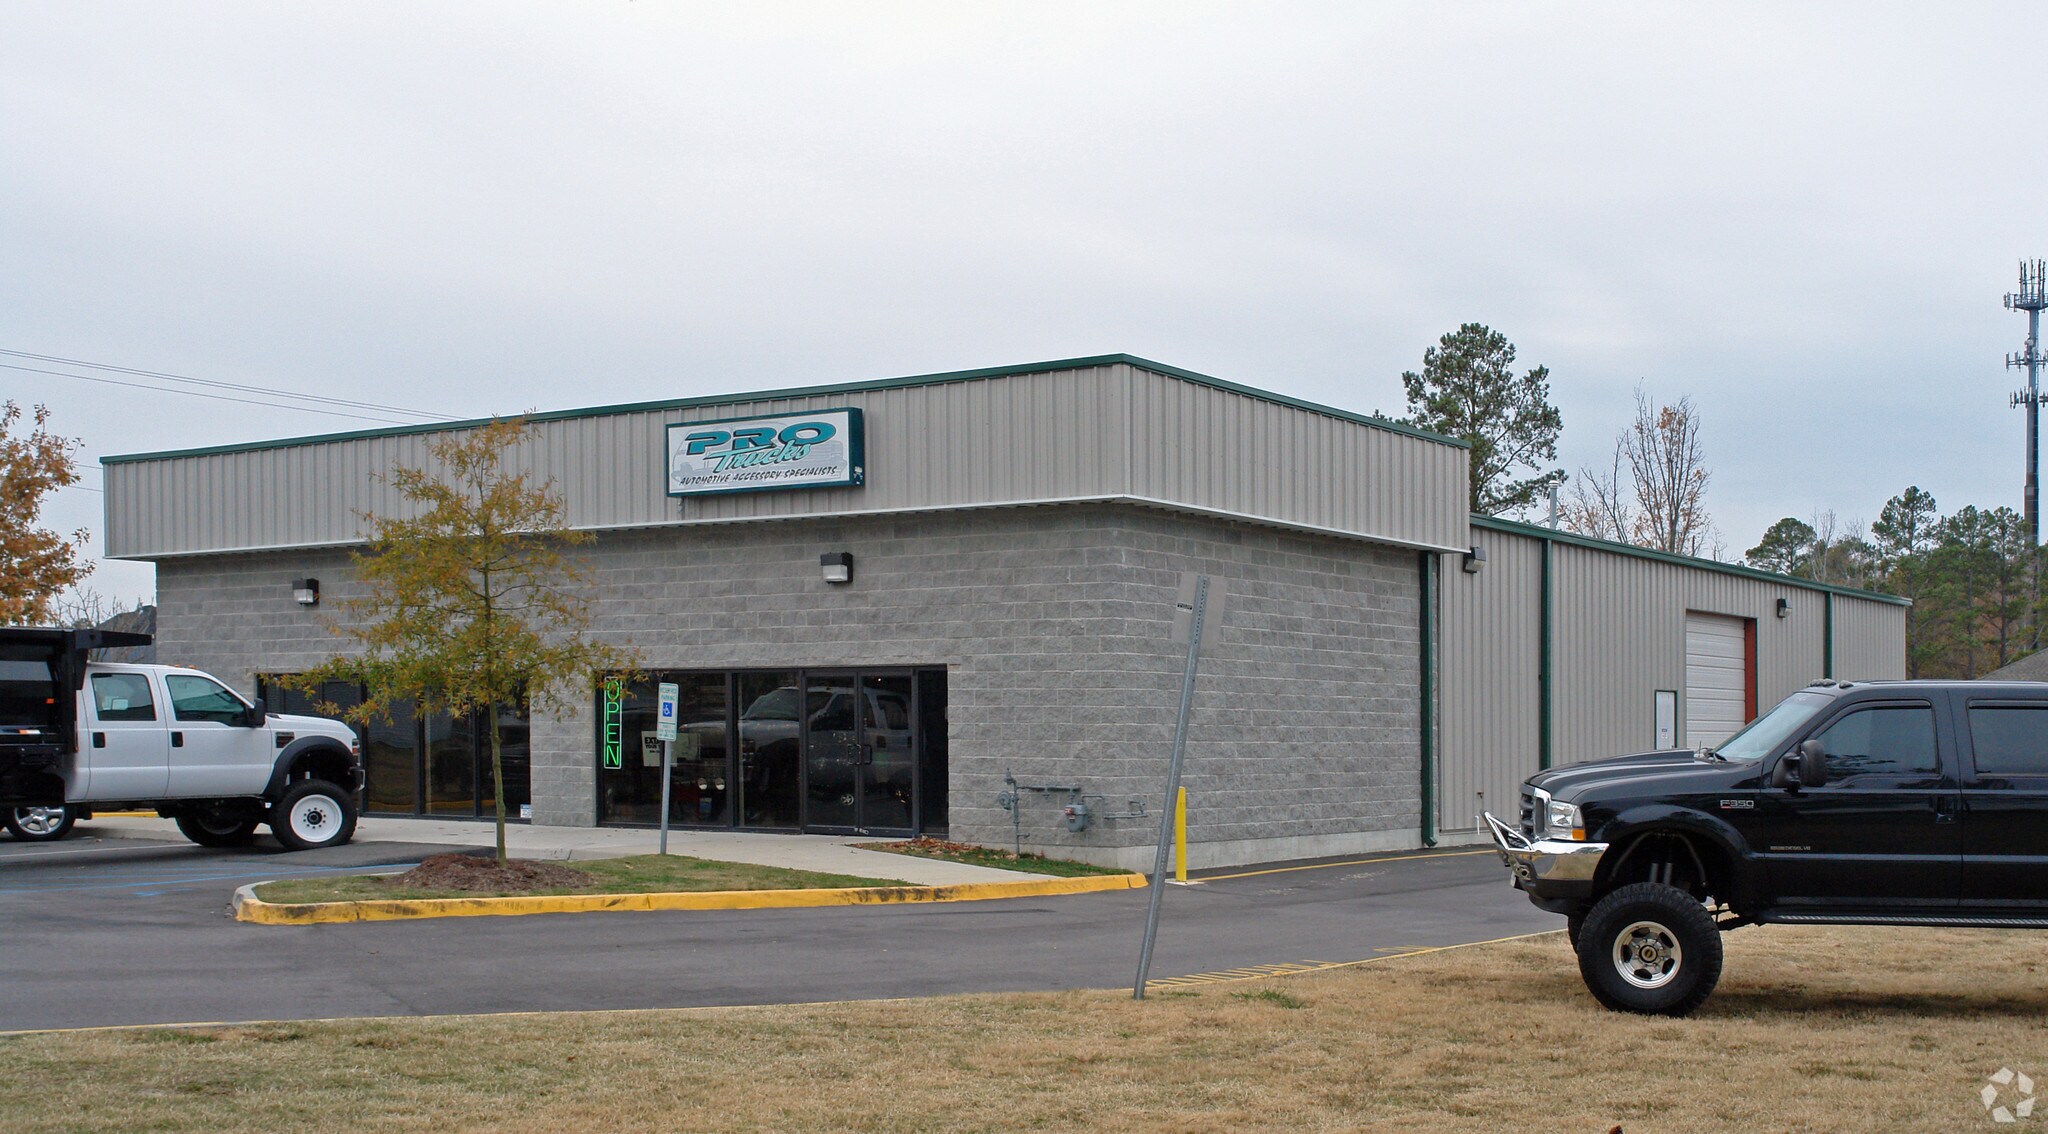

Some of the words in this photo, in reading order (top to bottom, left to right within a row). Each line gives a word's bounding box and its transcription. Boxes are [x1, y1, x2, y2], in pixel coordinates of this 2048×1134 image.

[685, 422, 836, 455] PRO
[703, 439, 811, 473] Trucks
[679, 474, 730, 486] AUTOMOTIVE
[733, 471, 781, 481] ACCESSORY
[784, 466, 838, 478] SPECIALISTS
[606, 680, 620, 766] OPEN
[1719, 799, 1755, 807] F350
